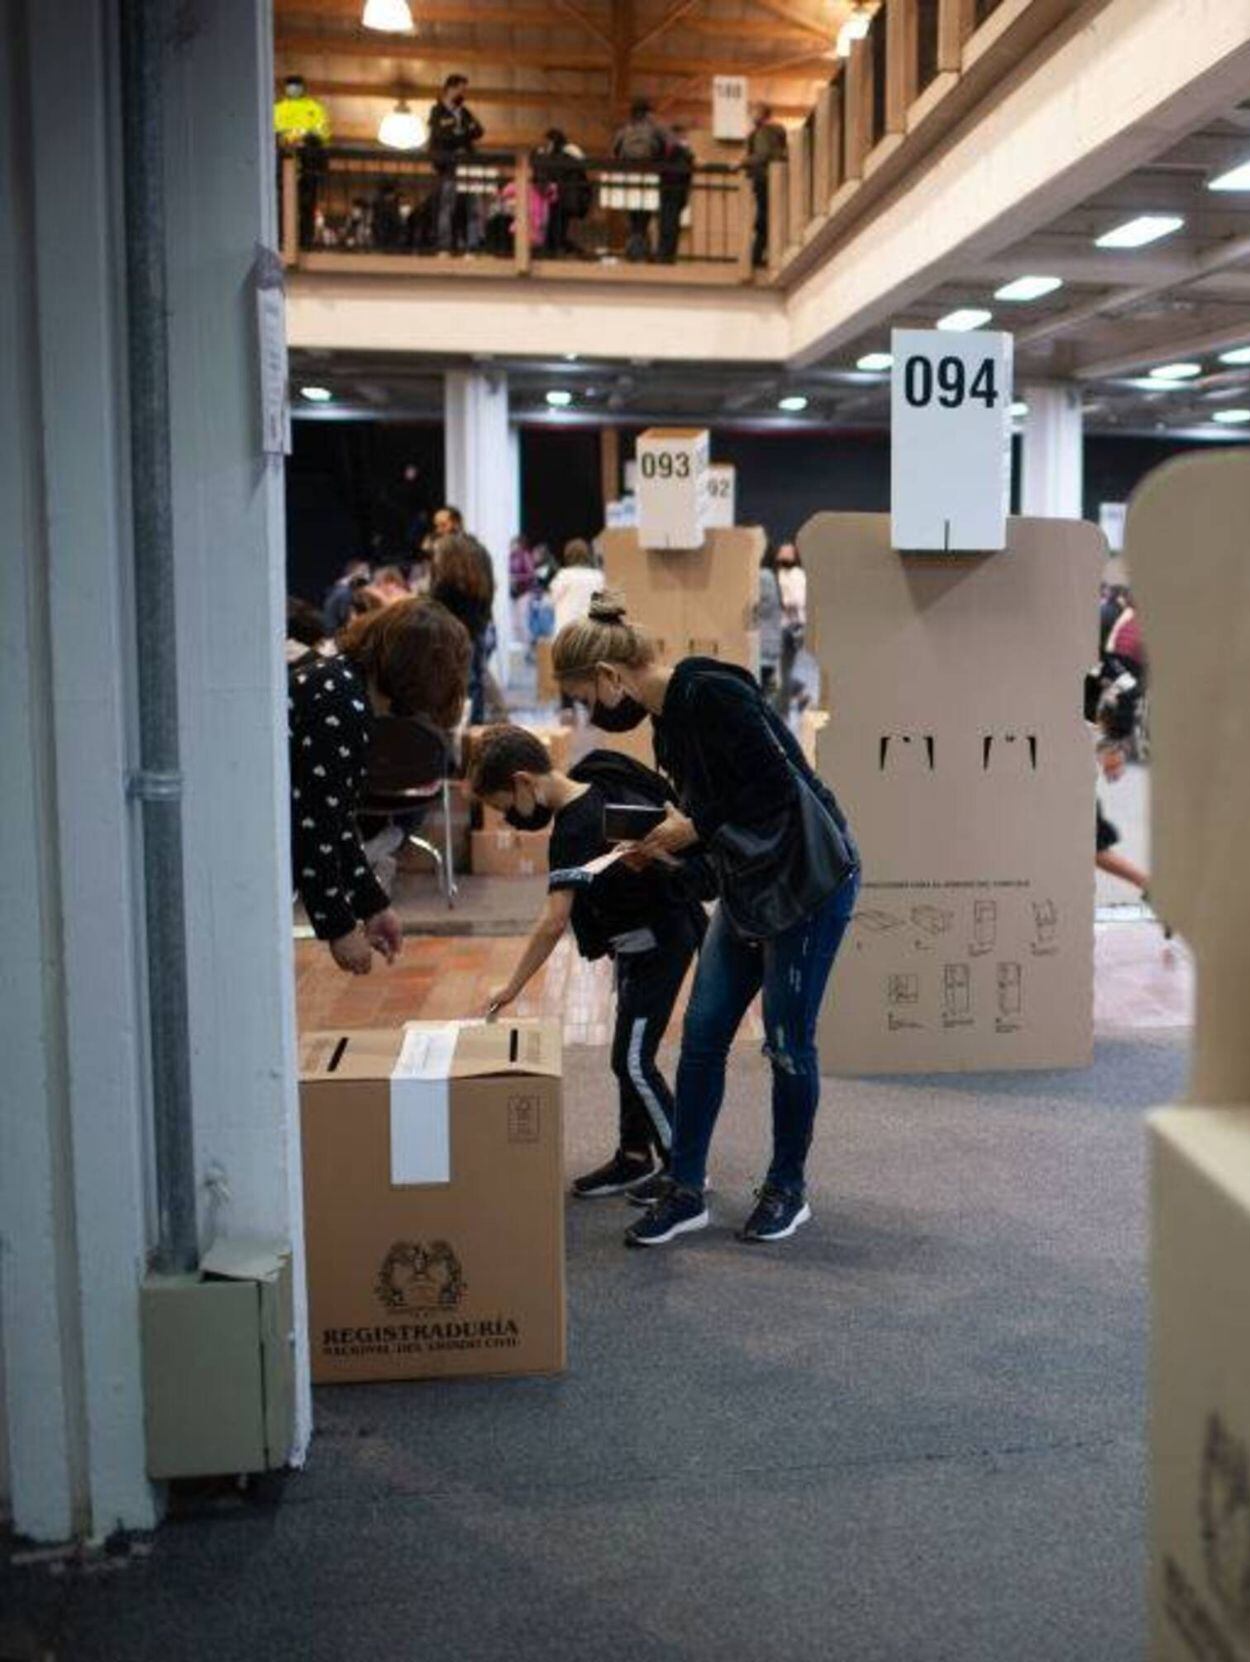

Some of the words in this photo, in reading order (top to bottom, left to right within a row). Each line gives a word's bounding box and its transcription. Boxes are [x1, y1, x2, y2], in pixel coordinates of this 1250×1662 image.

[904, 355, 998, 409] 094
[641, 451, 691, 479] 093
[706, 478, 730, 499] 92
